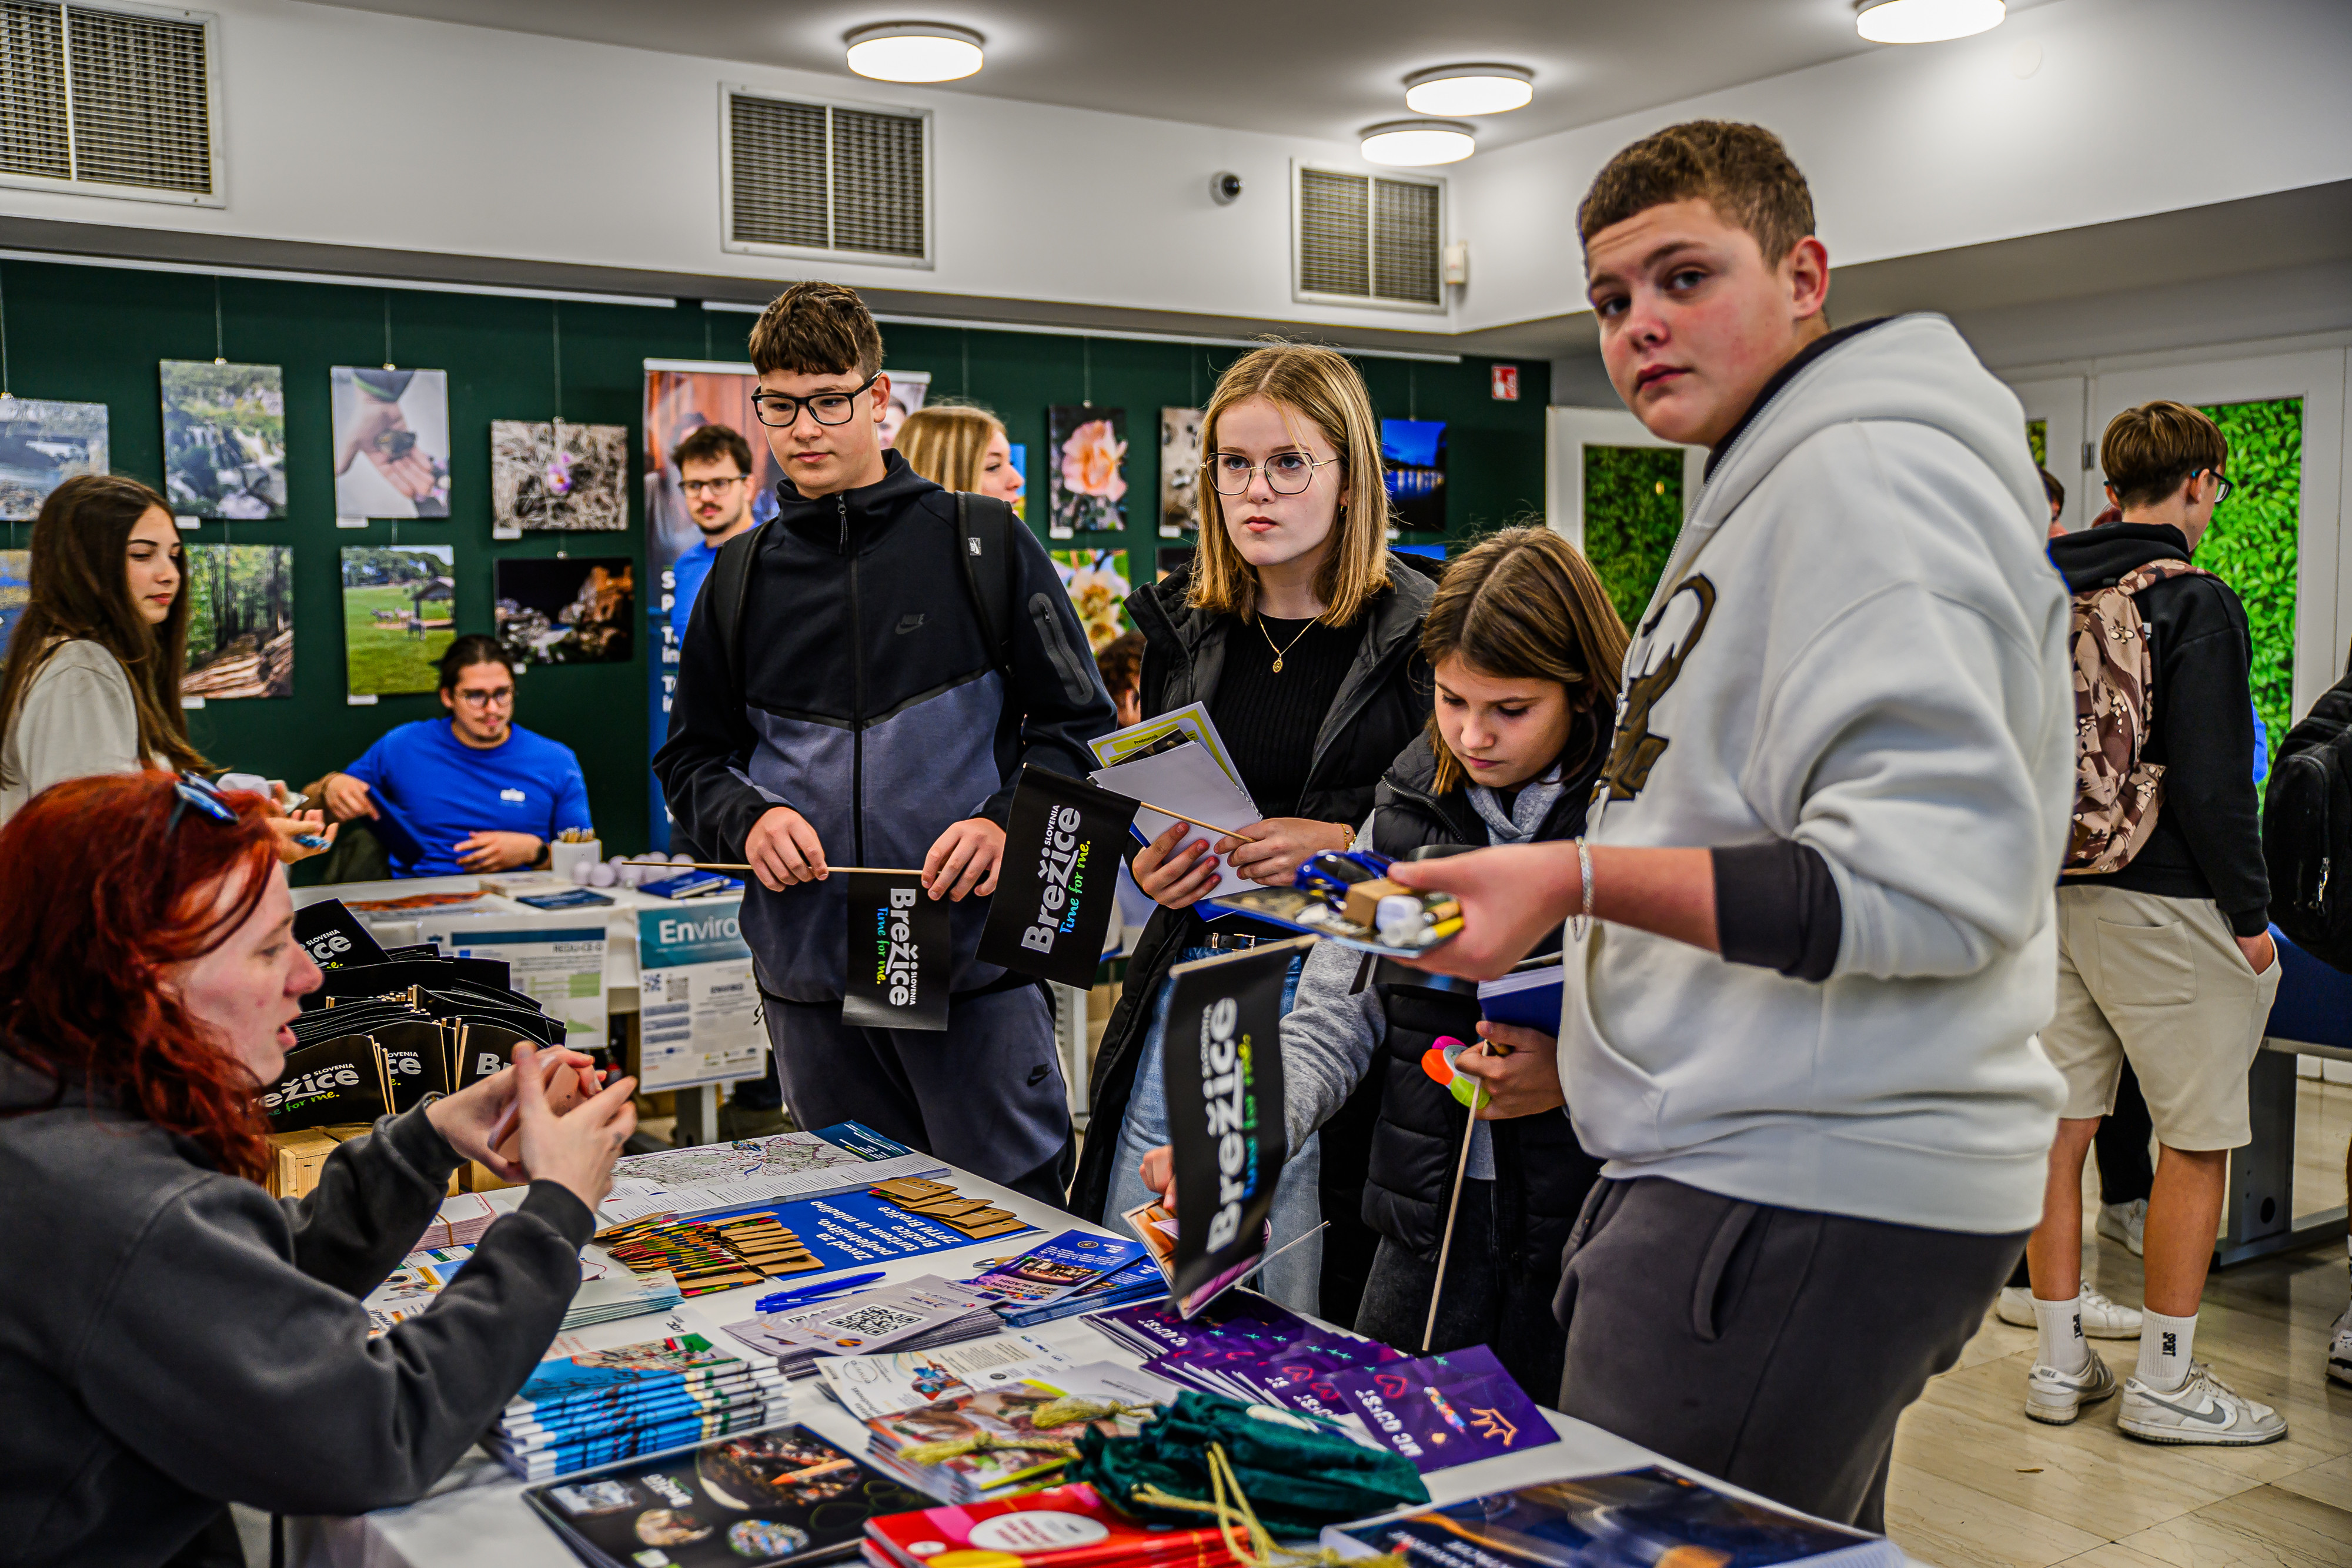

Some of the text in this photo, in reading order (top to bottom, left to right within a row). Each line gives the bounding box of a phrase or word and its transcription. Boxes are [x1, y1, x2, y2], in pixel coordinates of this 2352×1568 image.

[1133, 734, 1159, 745] Predmetnik
[1044, 805, 1060, 846] SLOVENIA
[1021, 808, 1081, 954] Brežice
[1060, 841, 1091, 933] Time for me.
[306, 929, 340, 947] SLOVENIA
[659, 915, 740, 944] Enviro
[877, 907, 890, 984] Time for me.
[886, 888, 918, 1006] Brežice
[910, 971, 918, 1005] SLOVENIA
[313, 1063, 355, 1076] SLOVENIA
[259, 1069, 360, 1108] ežice
[286, 1099, 306, 1112] for
[310, 1091, 340, 1103] me.
[1203, 998, 1245, 1253] Brežice
[810, 1201, 920, 1252] turizem in mladino
[817, 1218, 899, 1256] podjetništvo,
[878, 1206, 963, 1244] ZPTM Brežice
[891, 1225, 941, 1248] Brežice
[816, 1233, 875, 1261] Zavod za
[990, 1282, 1027, 1292] MLADIH
[998, 1278, 1035, 1288] MLADIH
[2162, 1332, 2176, 1358] SPORT
[1392, 1433, 1424, 1457] MC
